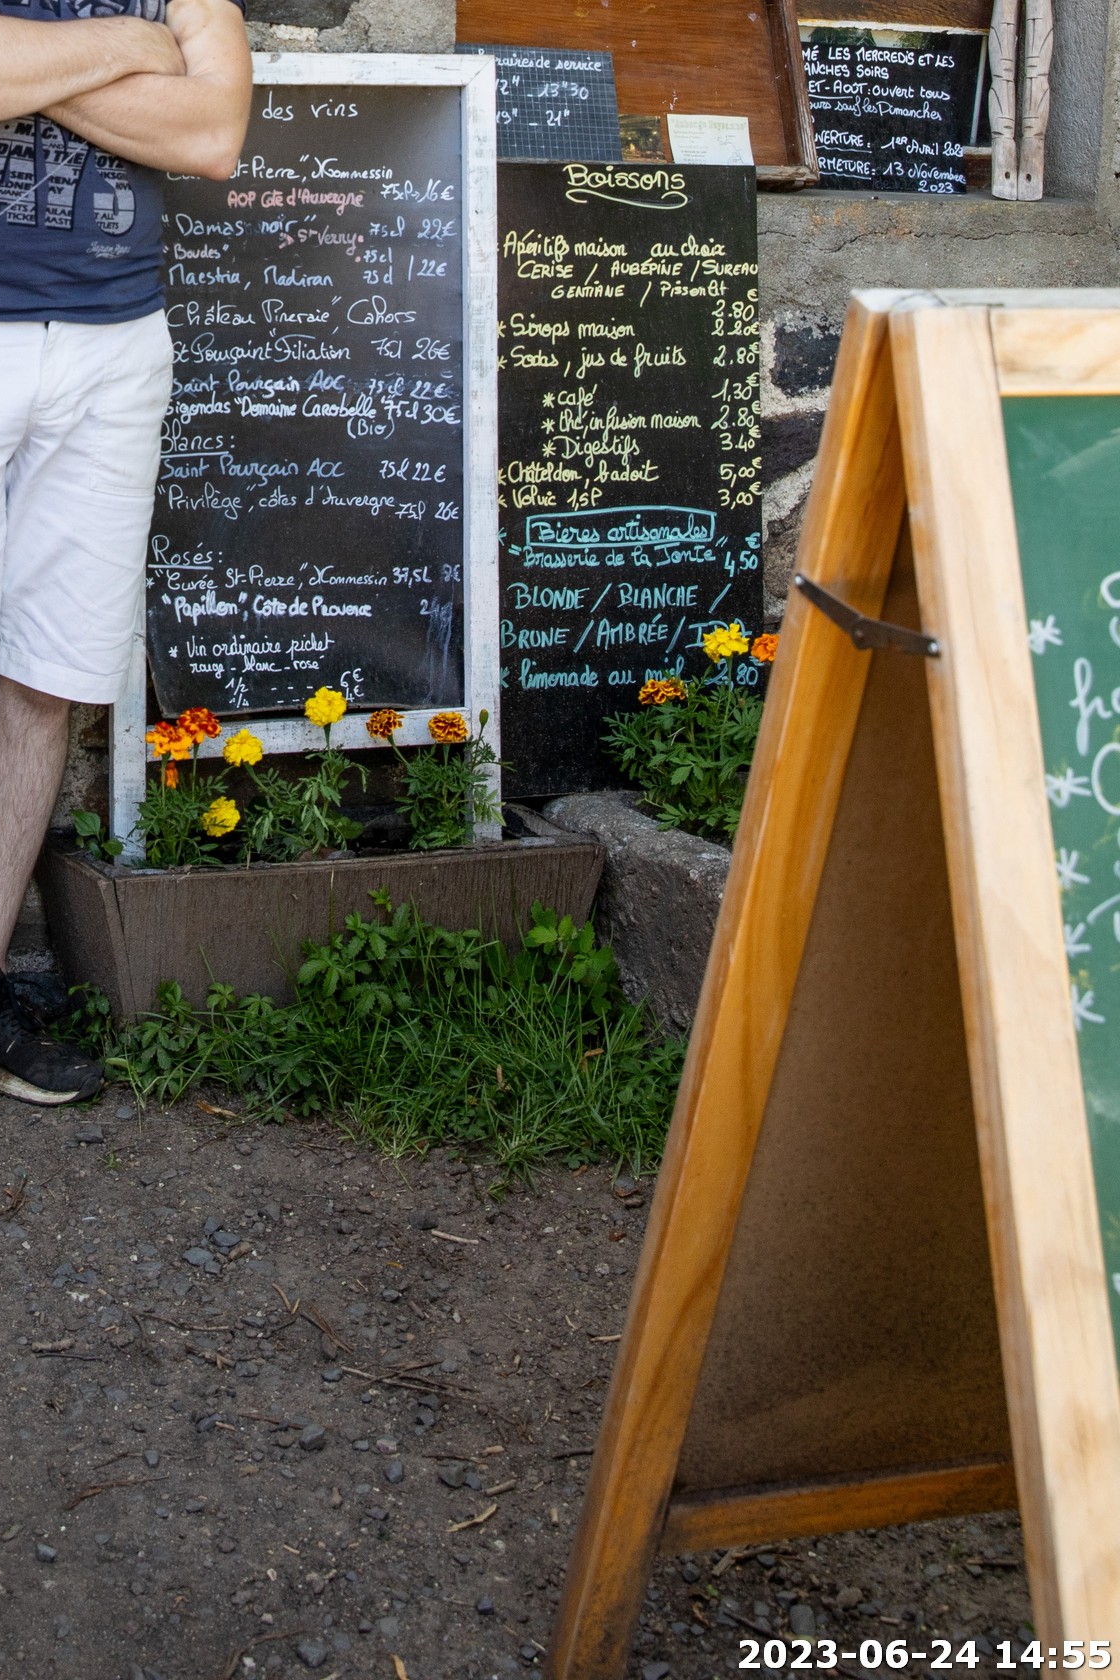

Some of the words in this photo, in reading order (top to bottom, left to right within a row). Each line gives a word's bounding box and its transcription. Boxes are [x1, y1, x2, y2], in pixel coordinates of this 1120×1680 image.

[535, 55, 551, 69] de
[555, 56, 602, 73] service
[828, 47, 851, 61] LES
[918, 53, 933, 67] ET
[935, 55, 956, 68] LES
[262, 91, 294, 121] des
[311, 99, 358, 118] vins
[834, 96, 862, 117] sauf
[876, 100, 943, 121] Dimanches
[906, 138, 940, 157] Avril
[563, 164, 686, 190] Boissons
[883, 161, 905, 177] 13
[918, 179, 955, 194] 2023
[417, 218, 458, 240] 22€
[503, 229, 570, 265] Apéritifs
[574, 237, 628, 257] maison
[650, 243, 678, 257] au
[681, 234, 726, 258] choix
[264, 265, 334, 288] Madiran
[701, 260, 758, 277] SUREAU
[166, 299, 256, 327] Château
[347, 295, 417, 325] Cahors
[510, 313, 570, 346] Sirops
[577, 317, 635, 340] maison
[412, 337, 452, 361] 26€
[577, 347, 605, 380] jus
[609, 346, 628, 366] de
[634, 342, 687, 378] fruits
[171, 373, 220, 396] Saint
[589, 406, 647, 442] infusion
[651, 410, 702, 429] maison
[553, 435, 640, 468] Digestifs
[161, 458, 210, 480] Saint
[219, 454, 299, 486] Pourçain
[306, 458, 346, 478] AOC
[412, 462, 447, 483] 22€
[594, 460, 660, 483] badoit
[259, 485, 297, 507] côtes
[513, 485, 557, 509] Volvic
[605, 549, 625, 567] de
[631, 545, 653, 567] la
[288, 595, 309, 617] de
[507, 582, 590, 610] BLONDE
[617, 582, 698, 608] BLANCHE
[500, 619, 570, 649] BRUNE
[596, 613, 668, 651] AMBRÉE
[186, 635, 207, 658] Vin
[212, 634, 281, 658] ordinaire
[285, 632, 335, 660] pichet
[242, 655, 282, 673] blanc
[293, 655, 325, 670] rosé
[519, 658, 598, 690] limonade
[608, 667, 636, 685] au
